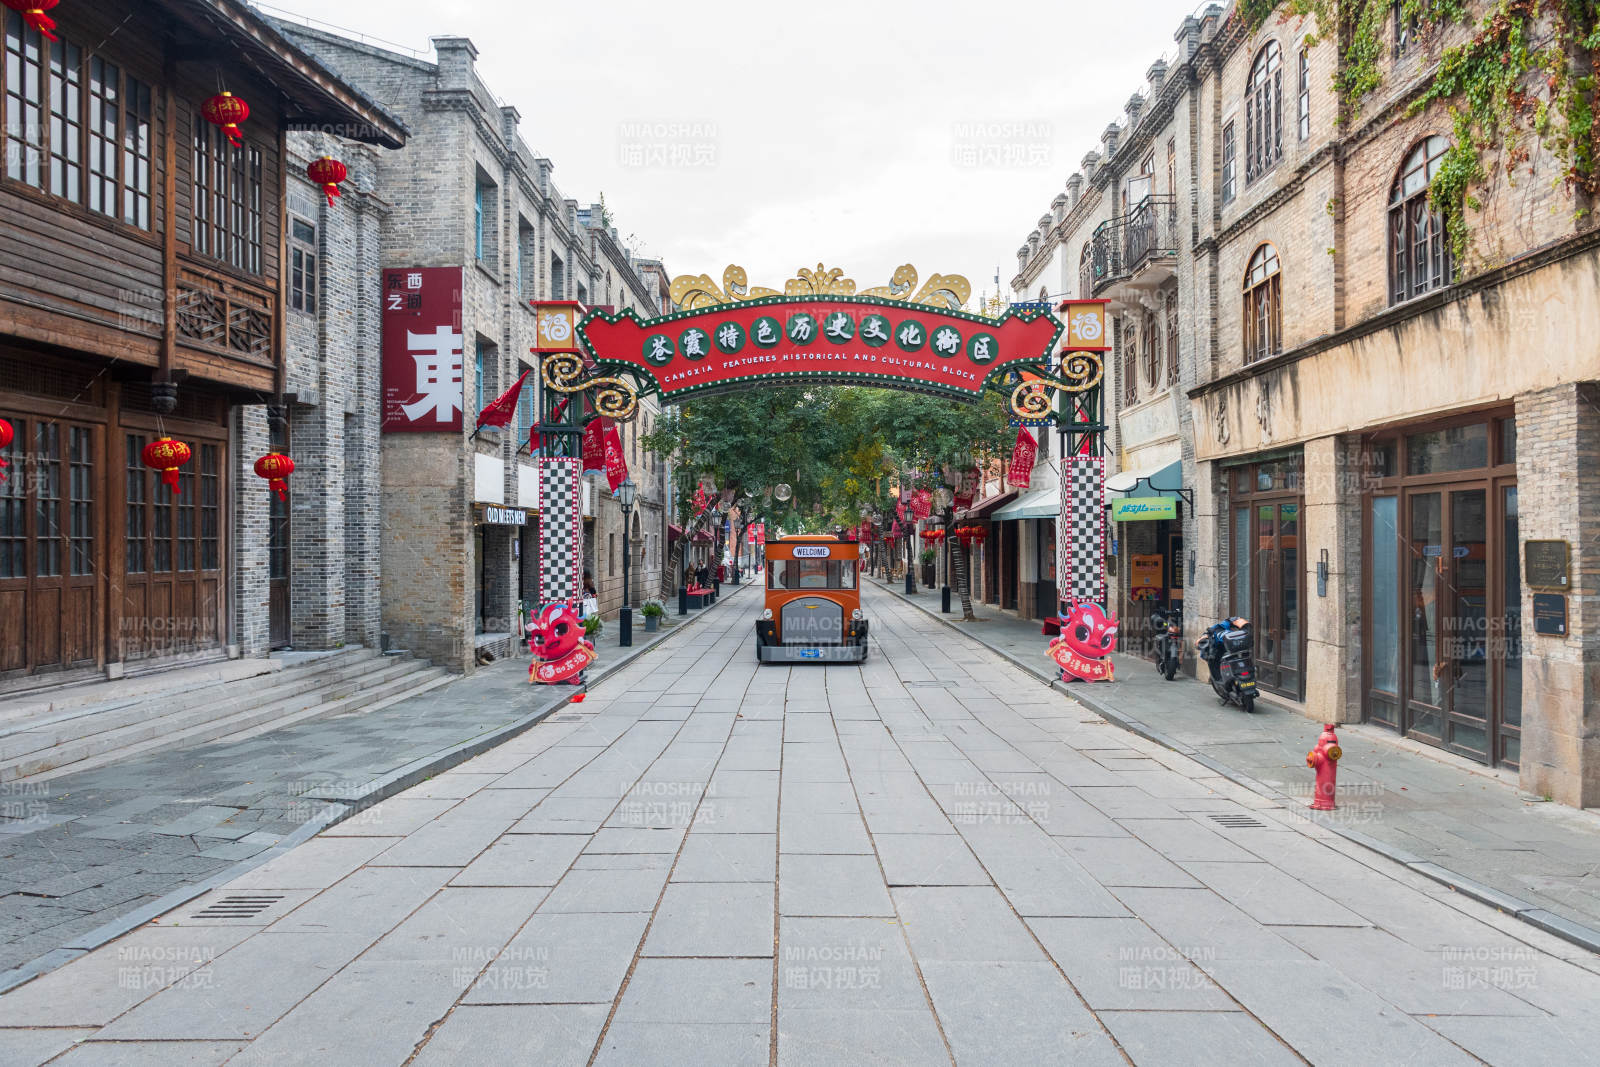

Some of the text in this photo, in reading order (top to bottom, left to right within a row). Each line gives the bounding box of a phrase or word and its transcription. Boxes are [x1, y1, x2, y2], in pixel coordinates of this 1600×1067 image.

[722, 354, 778, 369] FEATUERES
[783, 353, 848, 361] HISTORICAL
[853, 353, 877, 362] AND
[881, 356, 937, 371] CULTURAL
[942, 365, 976, 382] BLOCK
[487, 506, 499, 523] OLD
[796, 548, 827, 556] WELCOME
